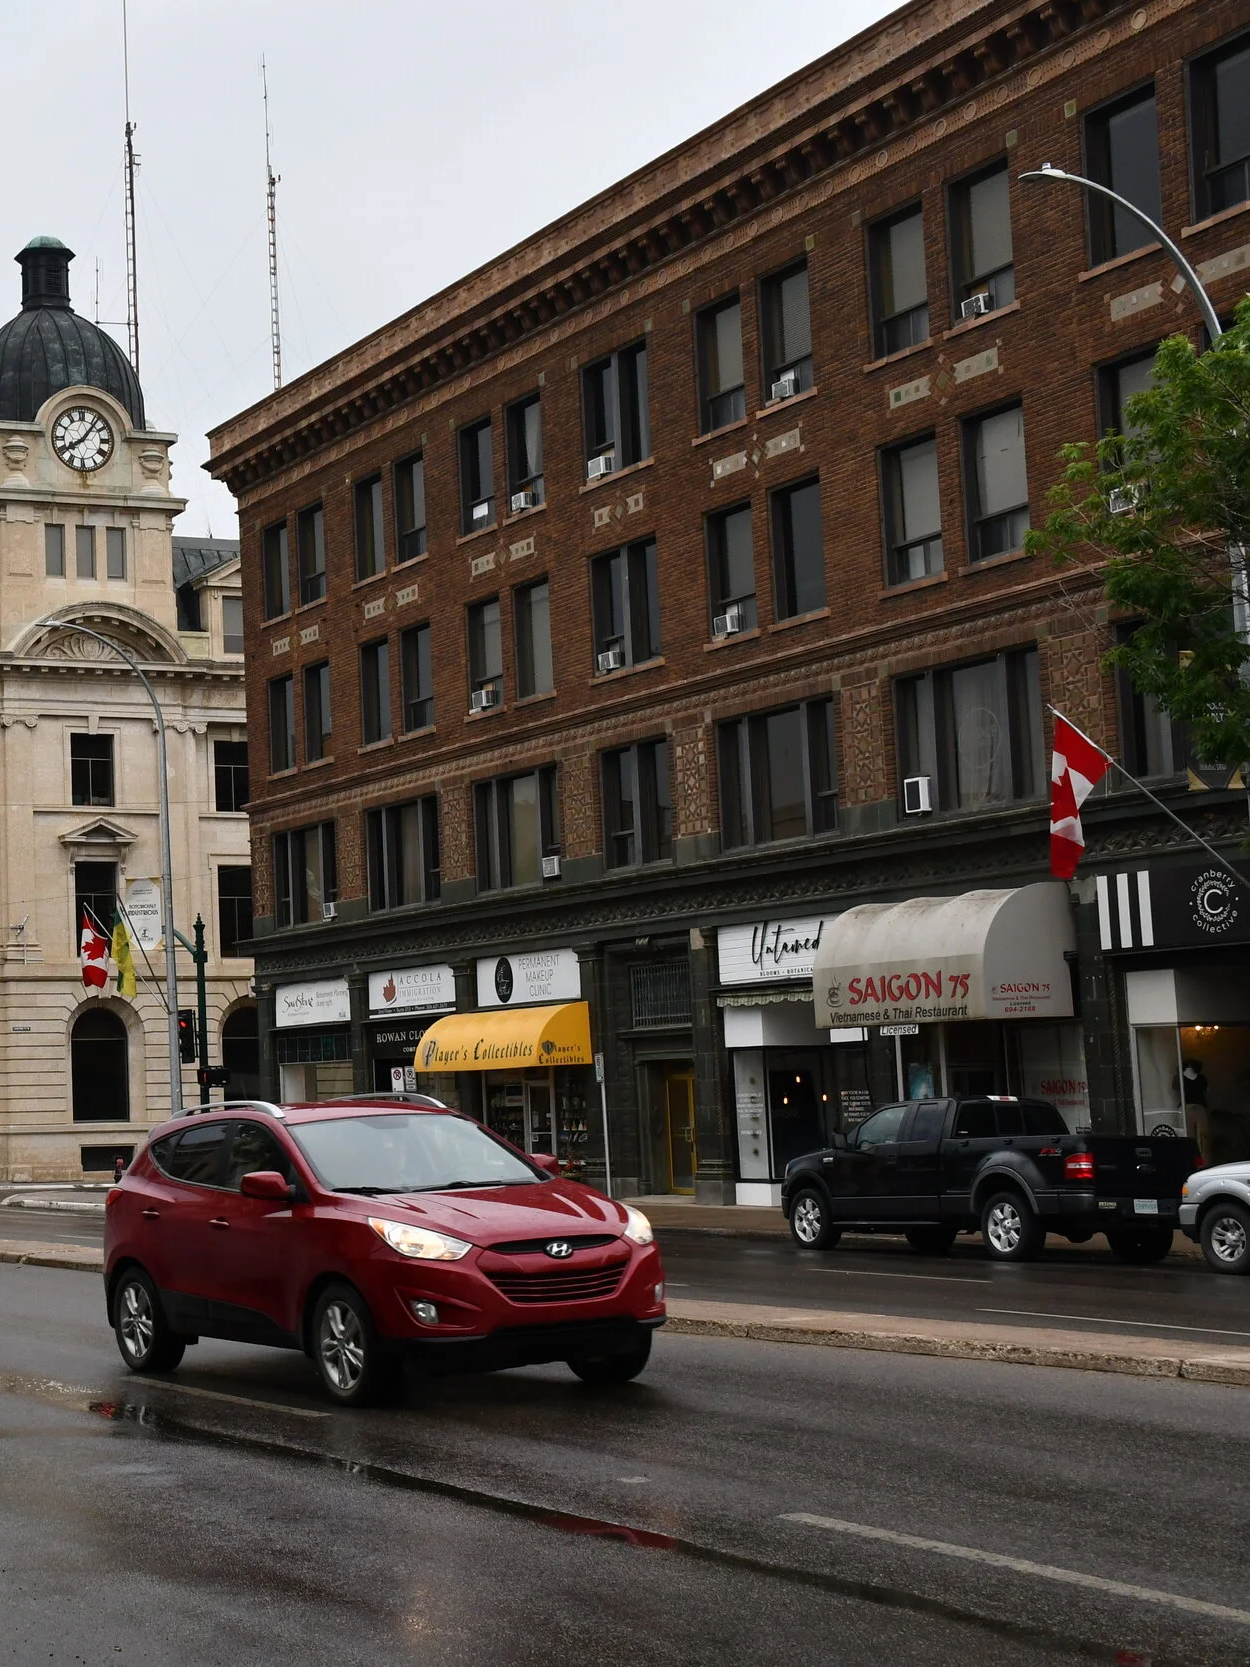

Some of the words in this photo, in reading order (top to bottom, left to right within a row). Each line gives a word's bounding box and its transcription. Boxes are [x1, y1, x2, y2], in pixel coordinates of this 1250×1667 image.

[1191, 869, 1236, 891] cranberry
[1192, 910, 1237, 933] collective
[752, 920, 824, 970] Untamed
[518, 954, 560, 970] PERMANENT
[399, 972, 442, 985] ACCOLA
[526, 969, 554, 982] MAKEUP
[399, 986, 441, 998] IMMIGRATION
[529, 983, 552, 996] CLINIC
[848, 970, 943, 1005] SAIGON
[948, 973, 971, 999] 75
[1000, 983, 1039, 993] SAIGON
[1042, 984, 1051, 992] 75
[830, 1011, 881, 1024] Vietnamese
[883, 1008, 890, 1020] &
[892, 1007, 913, 1019] Thai
[915, 1004, 968, 1018] Restaurant
[881, 1024, 917, 1035] Licensed
[376, 1031, 407, 1043] ROWAN
[409, 1030, 427, 1040] CLO
[425, 1040, 468, 1066] Player's
[473, 1038, 533, 1061] Collectibles
[547, 1042, 581, 1055] Player's
[538, 1053, 585, 1065] Collectibles
[1040, 1080, 1075, 1095] SAIGON
